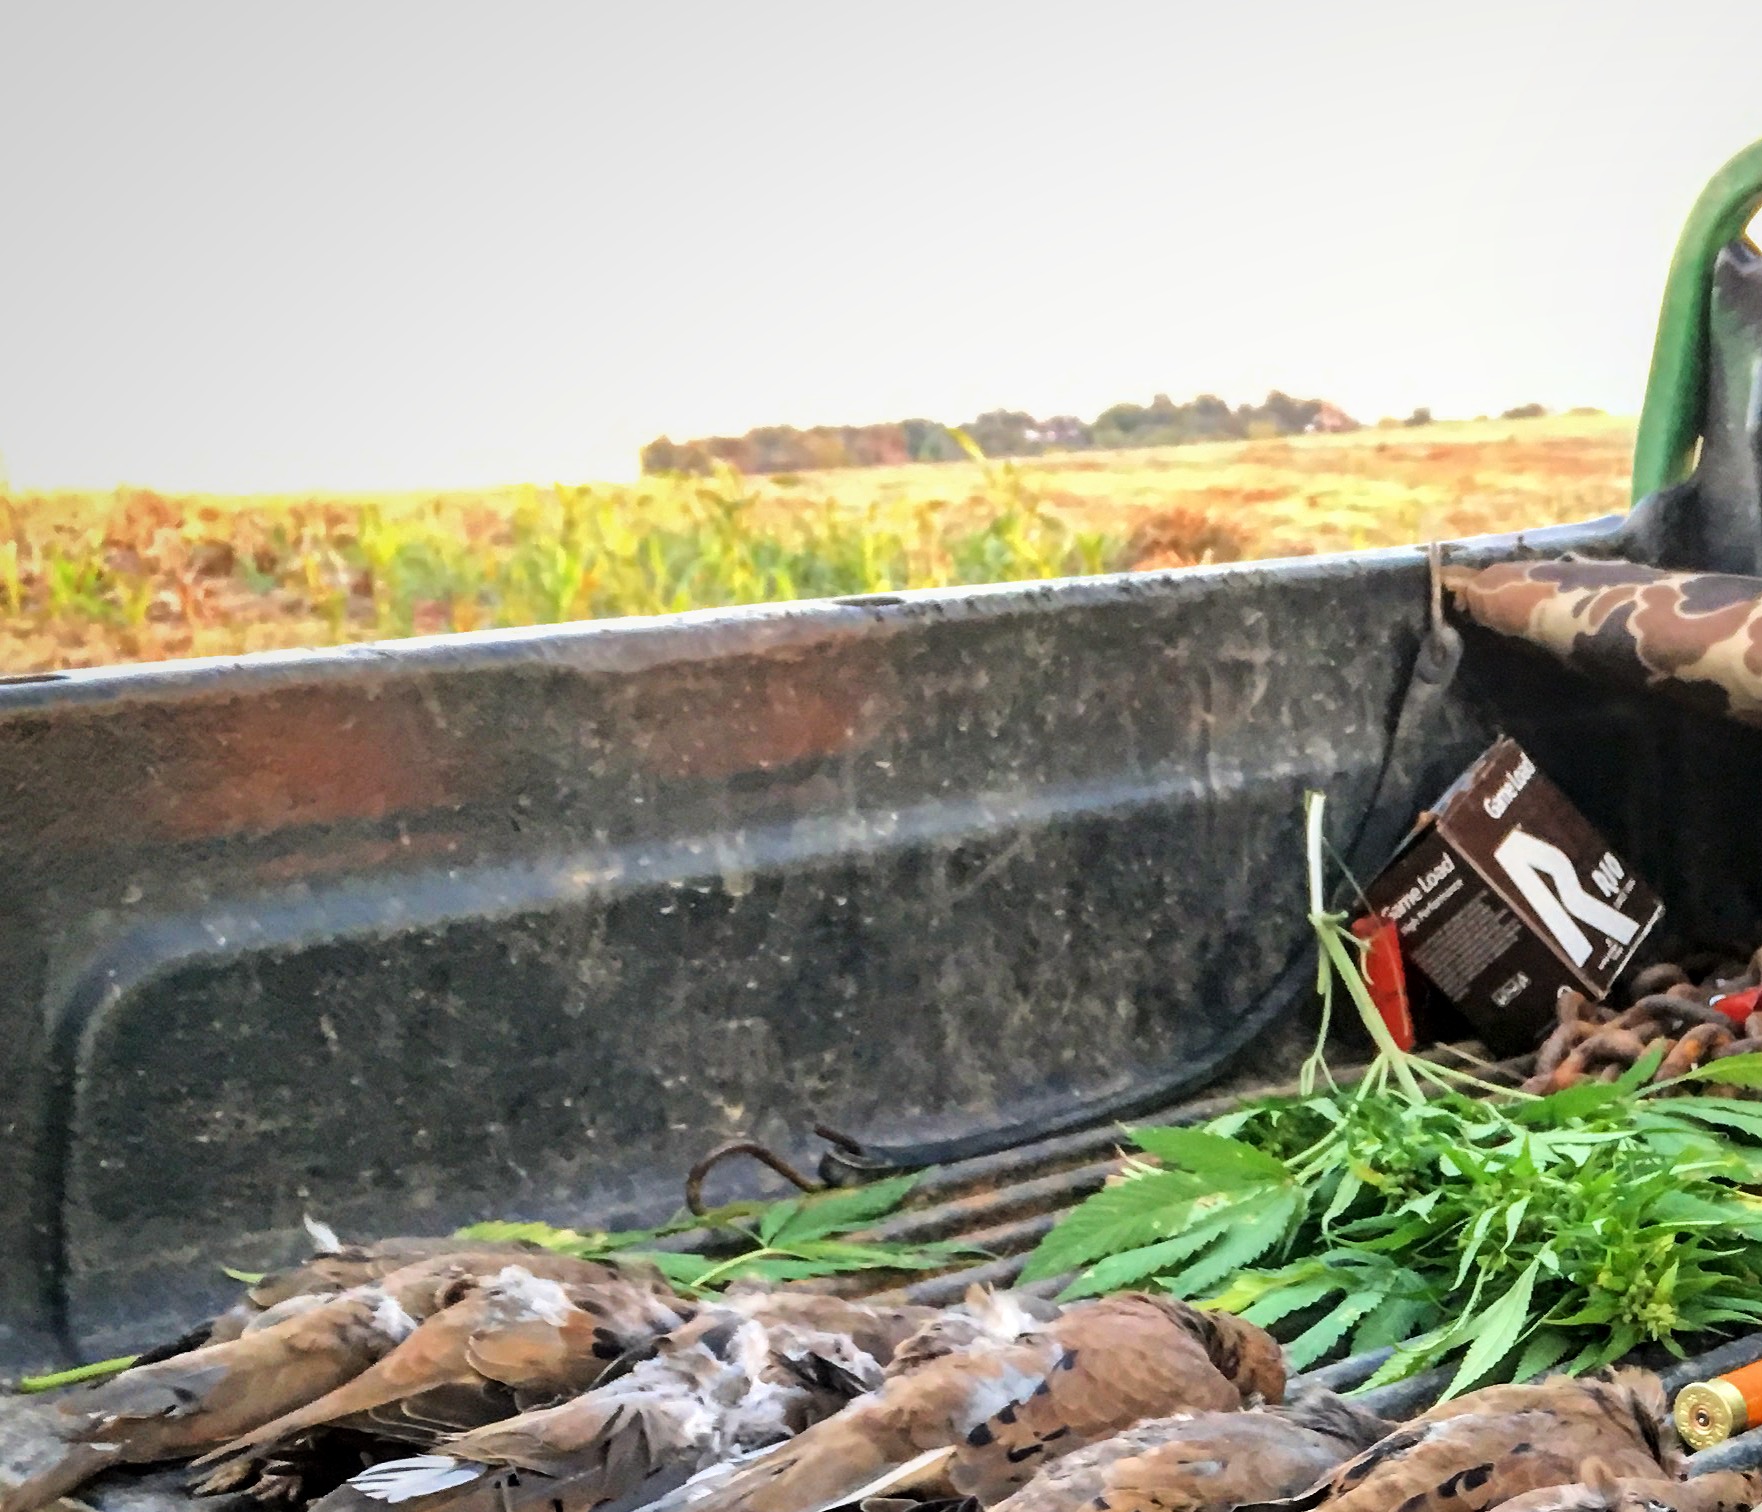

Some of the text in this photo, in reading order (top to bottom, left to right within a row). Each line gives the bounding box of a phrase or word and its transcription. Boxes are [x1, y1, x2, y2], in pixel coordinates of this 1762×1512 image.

[1483, 750, 1538, 820] Game Load
[1417, 851, 1456, 894] Load
[1591, 851, 1626, 898] RIO
